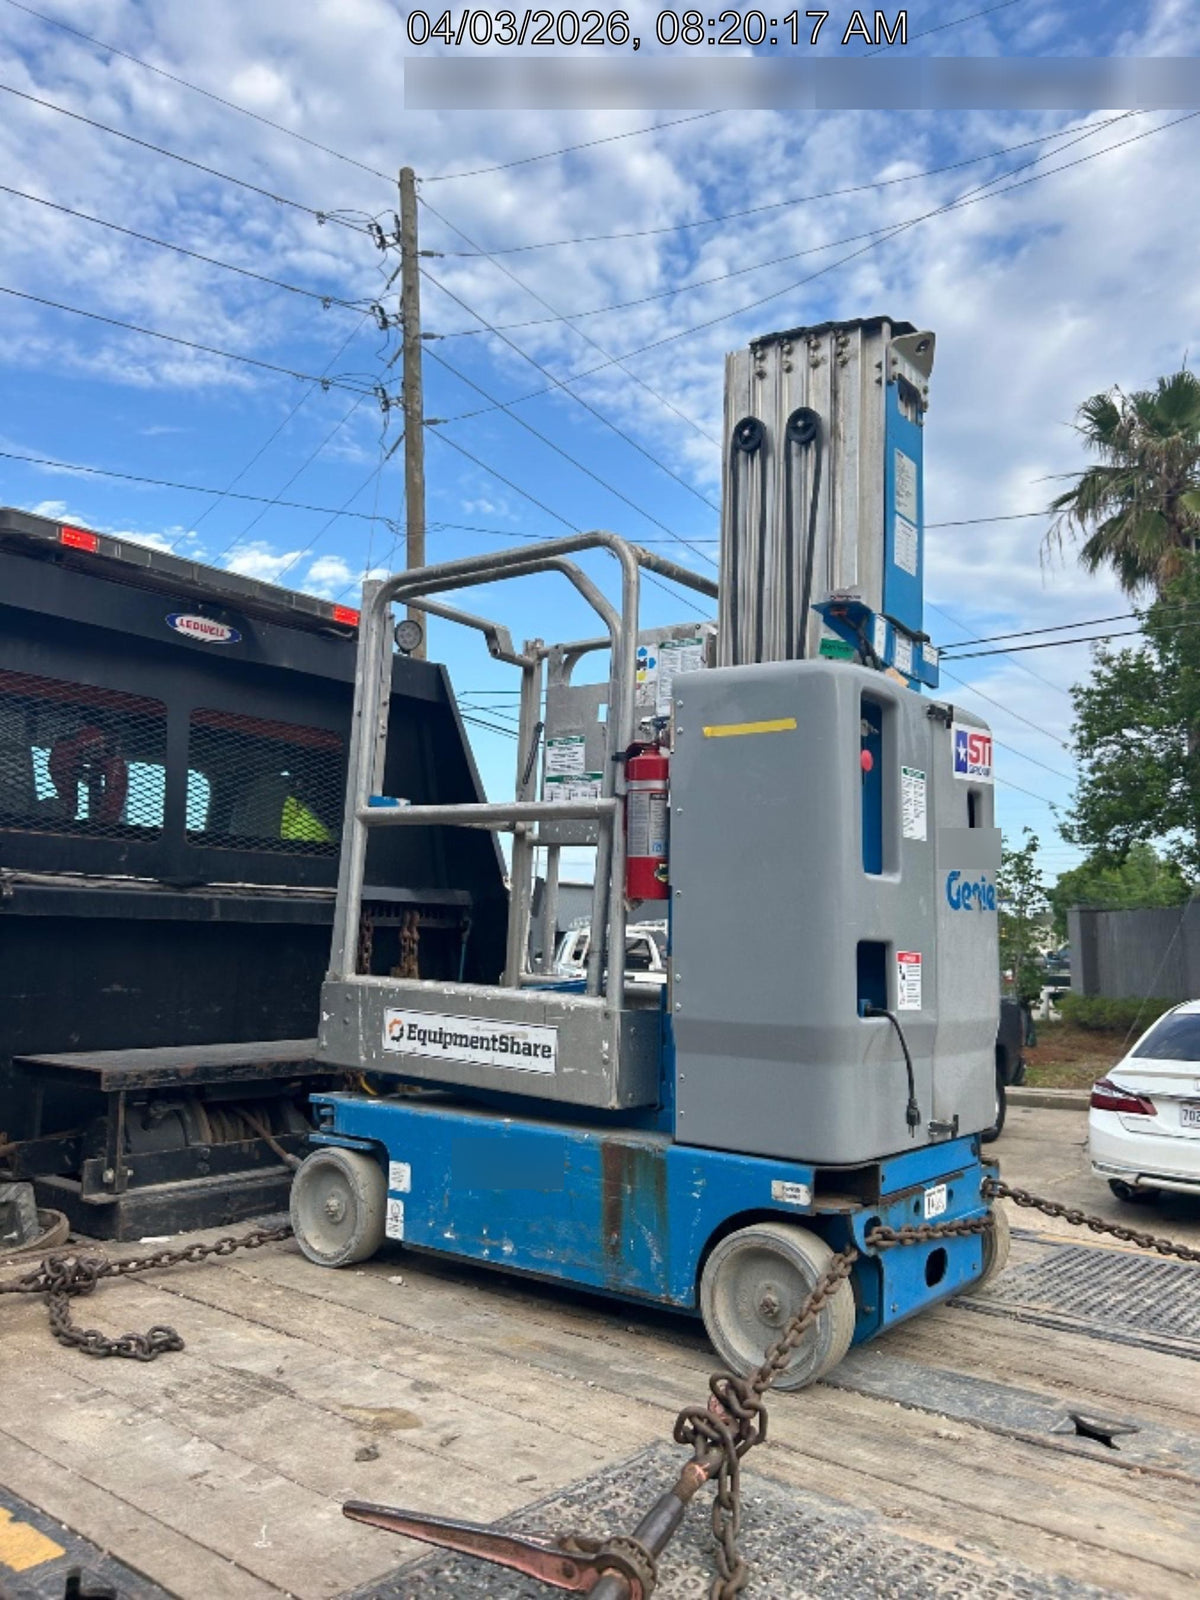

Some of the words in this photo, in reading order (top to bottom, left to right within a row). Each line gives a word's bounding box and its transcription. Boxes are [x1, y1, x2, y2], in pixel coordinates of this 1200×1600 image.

[180, 618, 225, 637] LEDWELL
[946, 870, 996, 912] Genie
[407, 1024, 552, 1058] EquipmentShare
